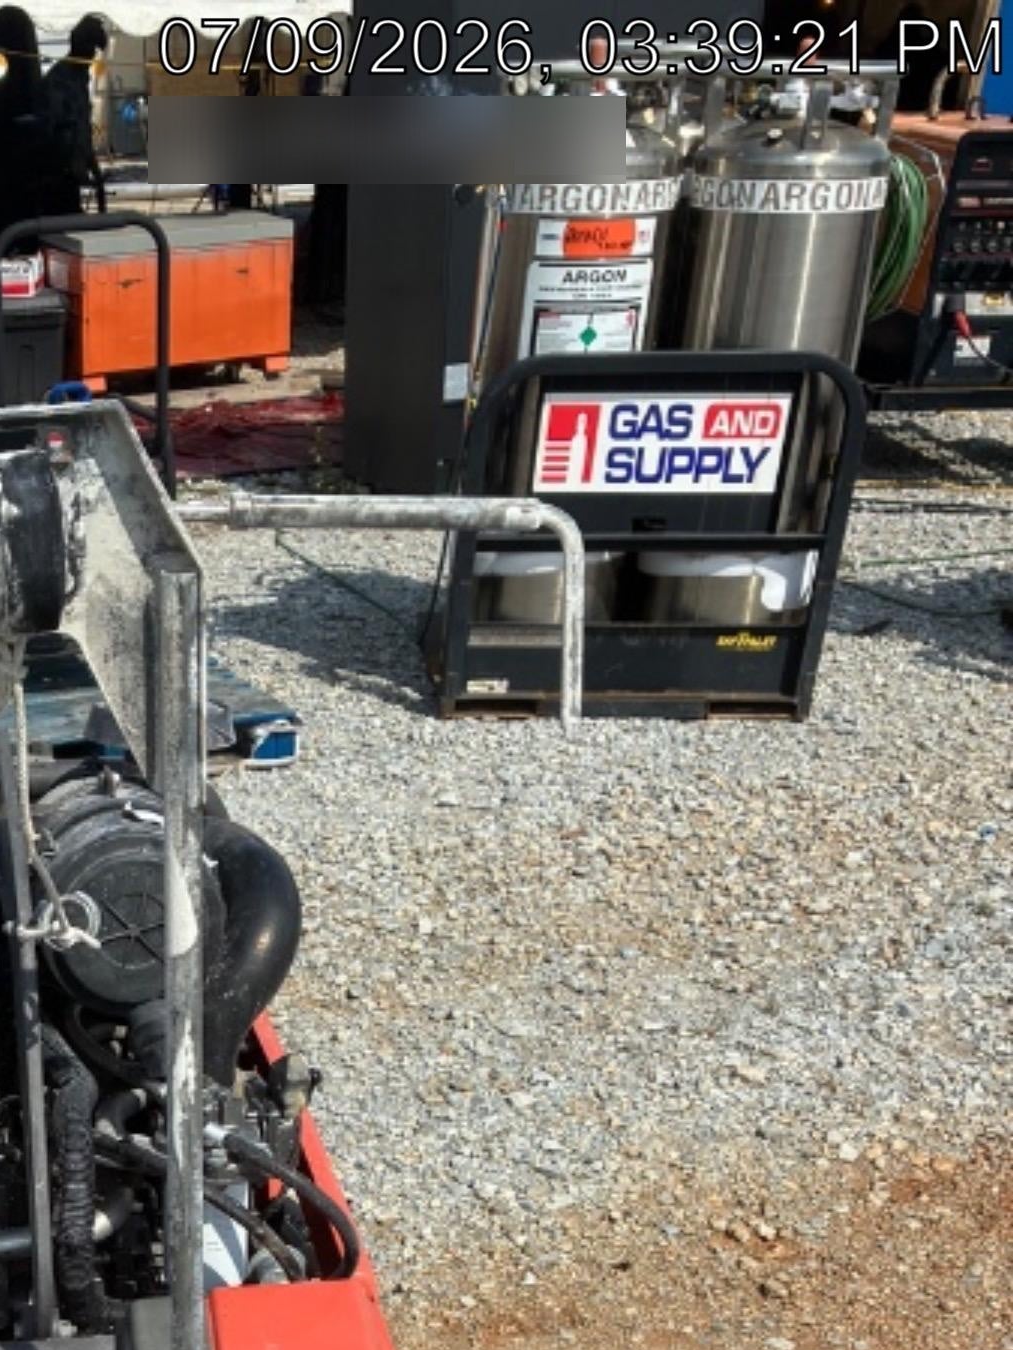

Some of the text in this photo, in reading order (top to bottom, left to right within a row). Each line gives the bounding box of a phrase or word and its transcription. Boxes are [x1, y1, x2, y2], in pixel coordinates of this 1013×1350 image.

[562, 269, 627, 283] ARGON
[608, 404, 775, 441] GAS AND
[604, 447, 771, 484] SUPPLY
